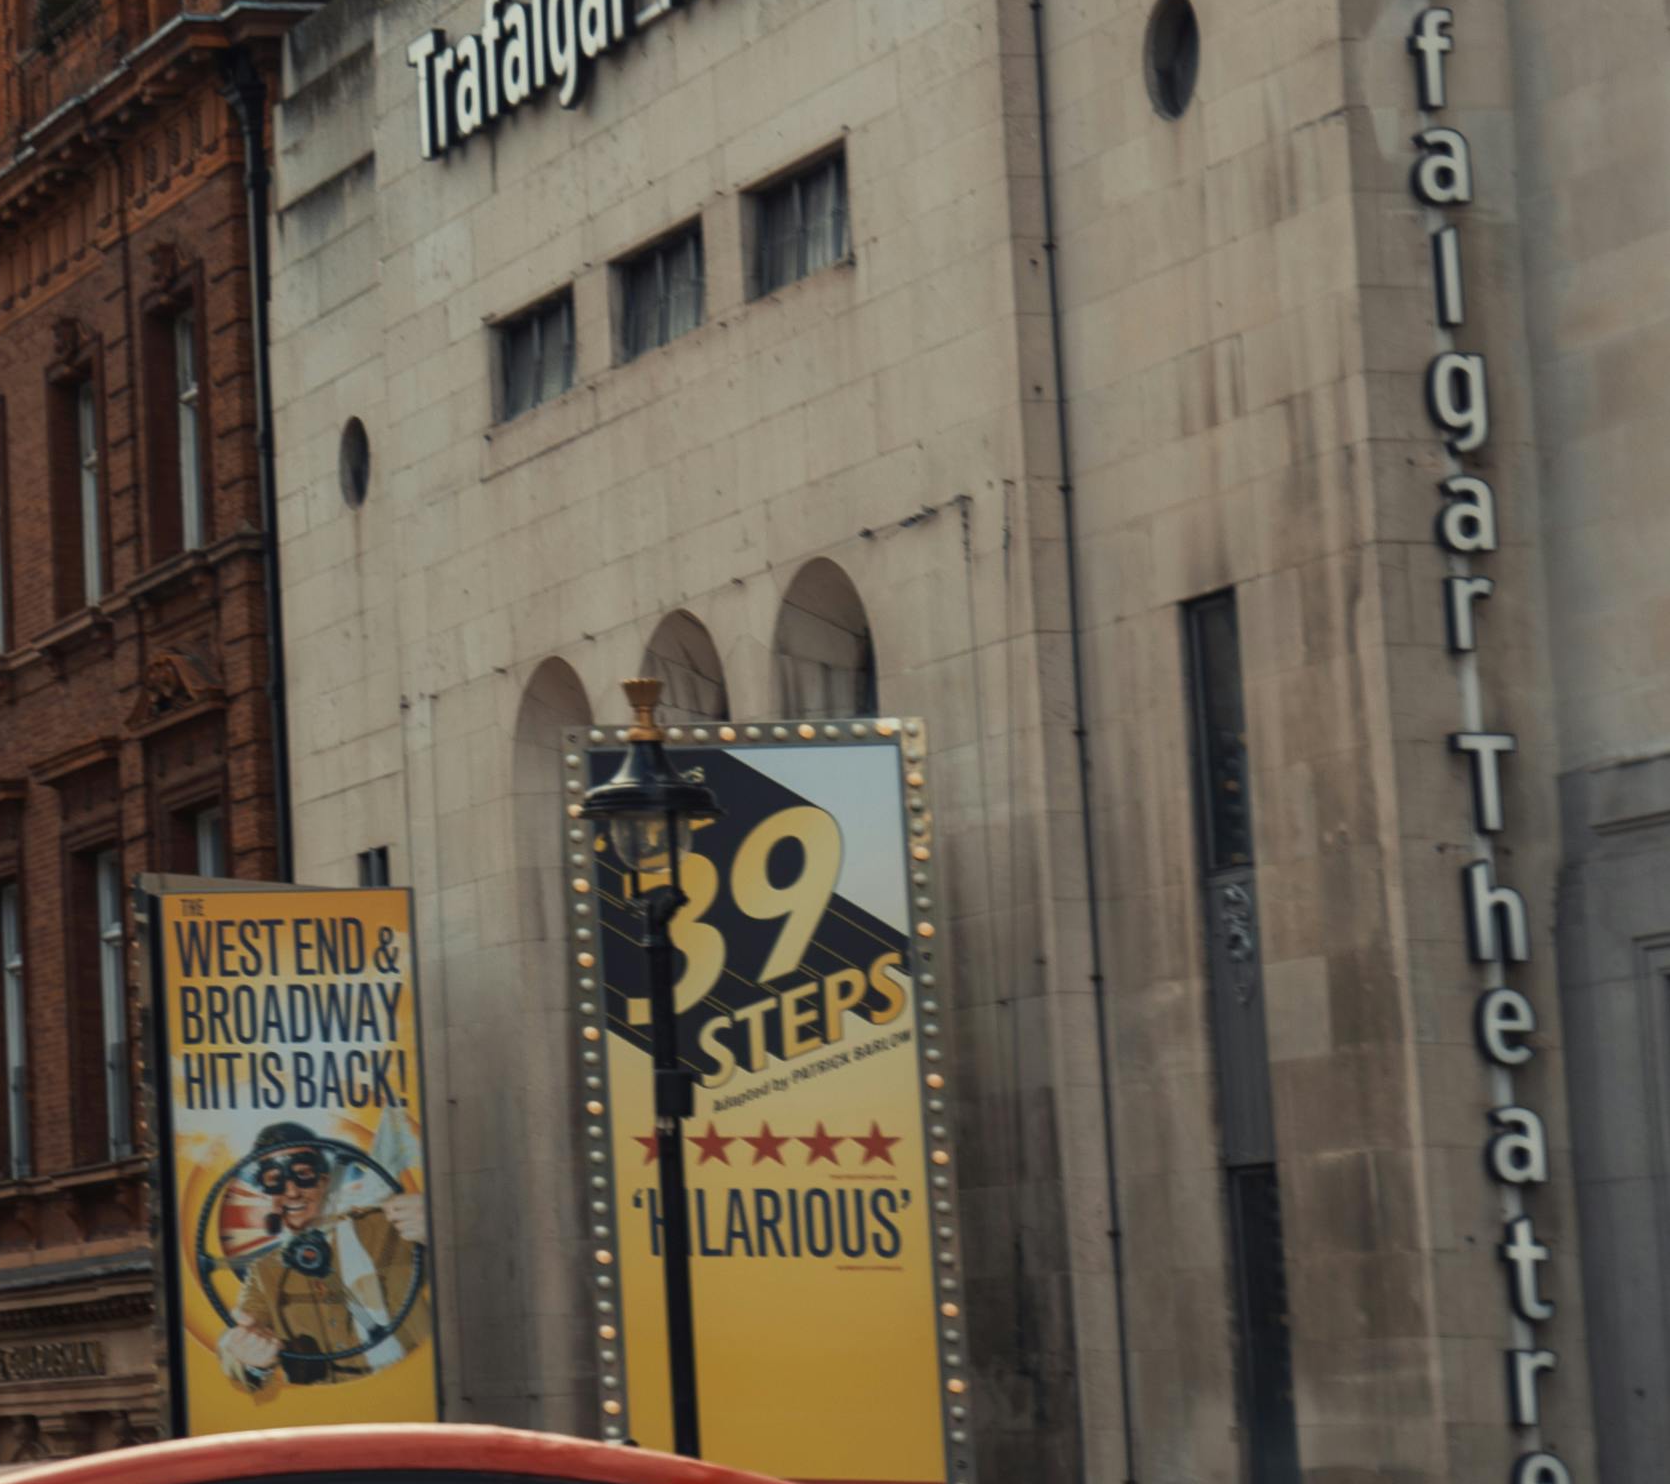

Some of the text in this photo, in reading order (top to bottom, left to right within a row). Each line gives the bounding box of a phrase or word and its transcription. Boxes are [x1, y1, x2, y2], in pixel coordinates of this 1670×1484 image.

[179, 898, 206, 917] THE
[173, 916, 401, 979] WEST END &
[179, 982, 403, 1045] BROADWAY
[697, 951, 906, 1089] STEPS
[852, 1029, 912, 1062] BARLOW
[183, 1049, 409, 1111] HIT IS BACK!
